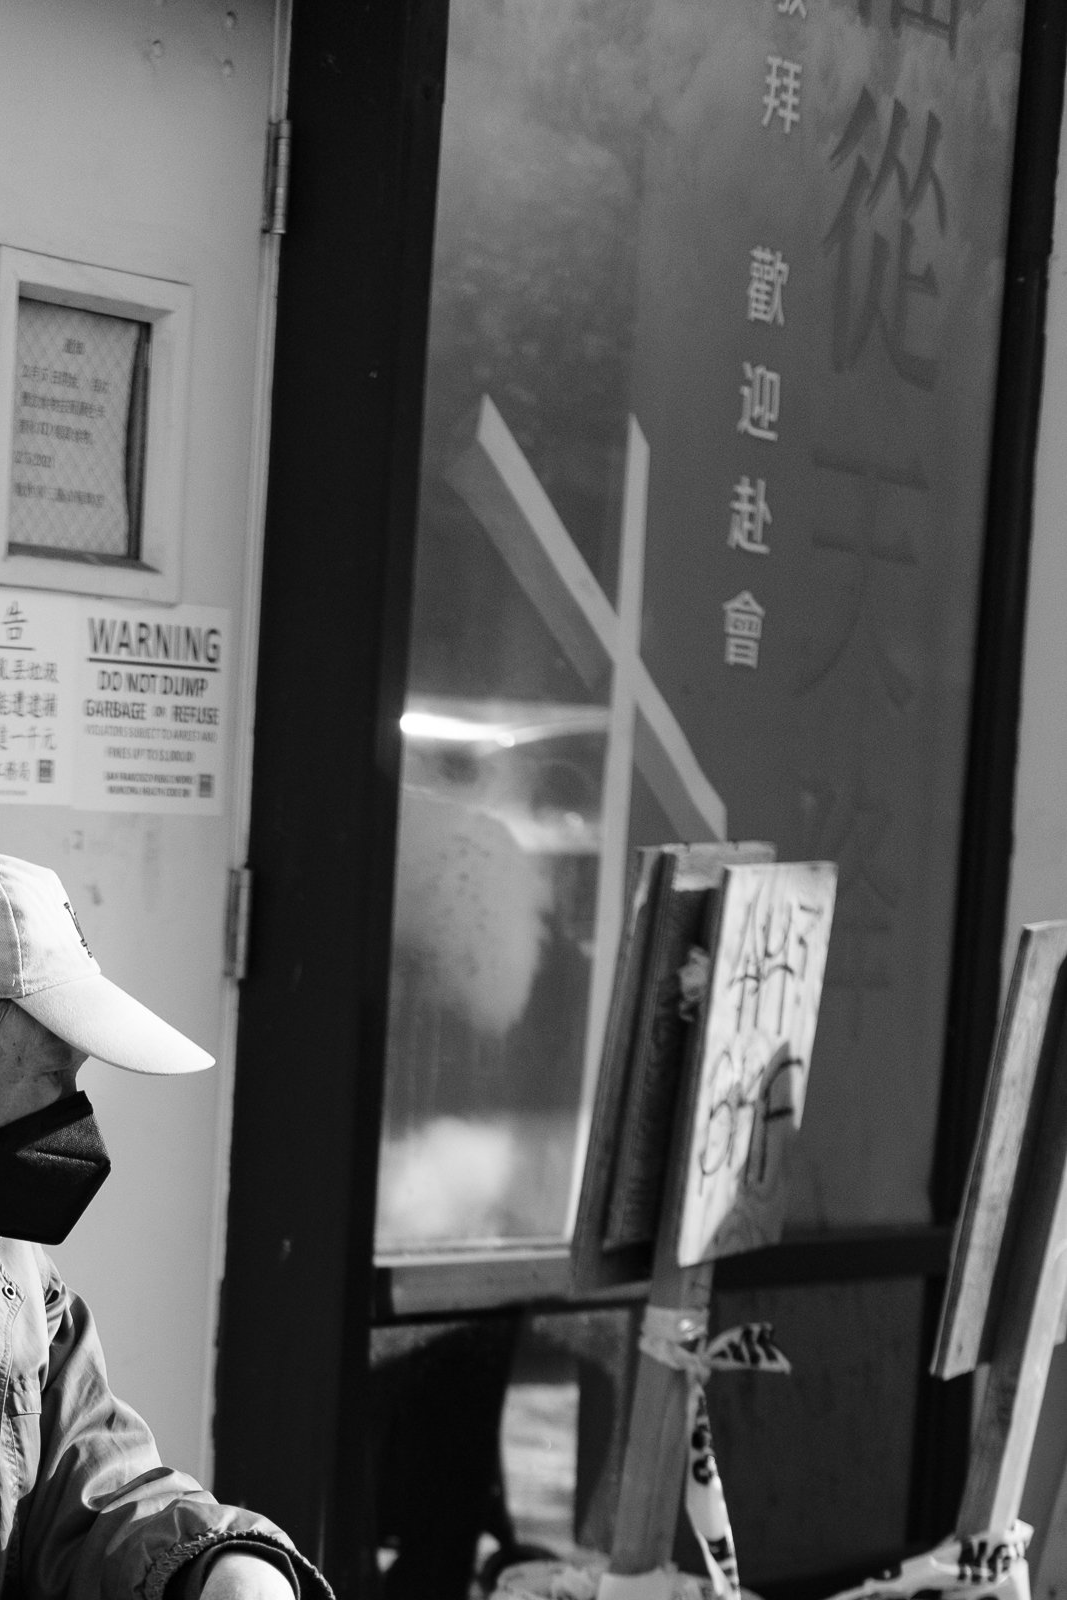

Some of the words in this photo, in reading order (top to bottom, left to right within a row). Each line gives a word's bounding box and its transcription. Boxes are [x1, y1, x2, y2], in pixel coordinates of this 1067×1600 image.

[722, 246, 790, 669] 歡迎赴會
[87, 617, 221, 664] WARNING
[98, 670, 122, 692] DO
[124, 672, 157, 694] NOT
[159, 675, 209, 698] DUMP
[84, 699, 147, 721] GARBAGE
[171, 704, 220, 726] REFUSE
